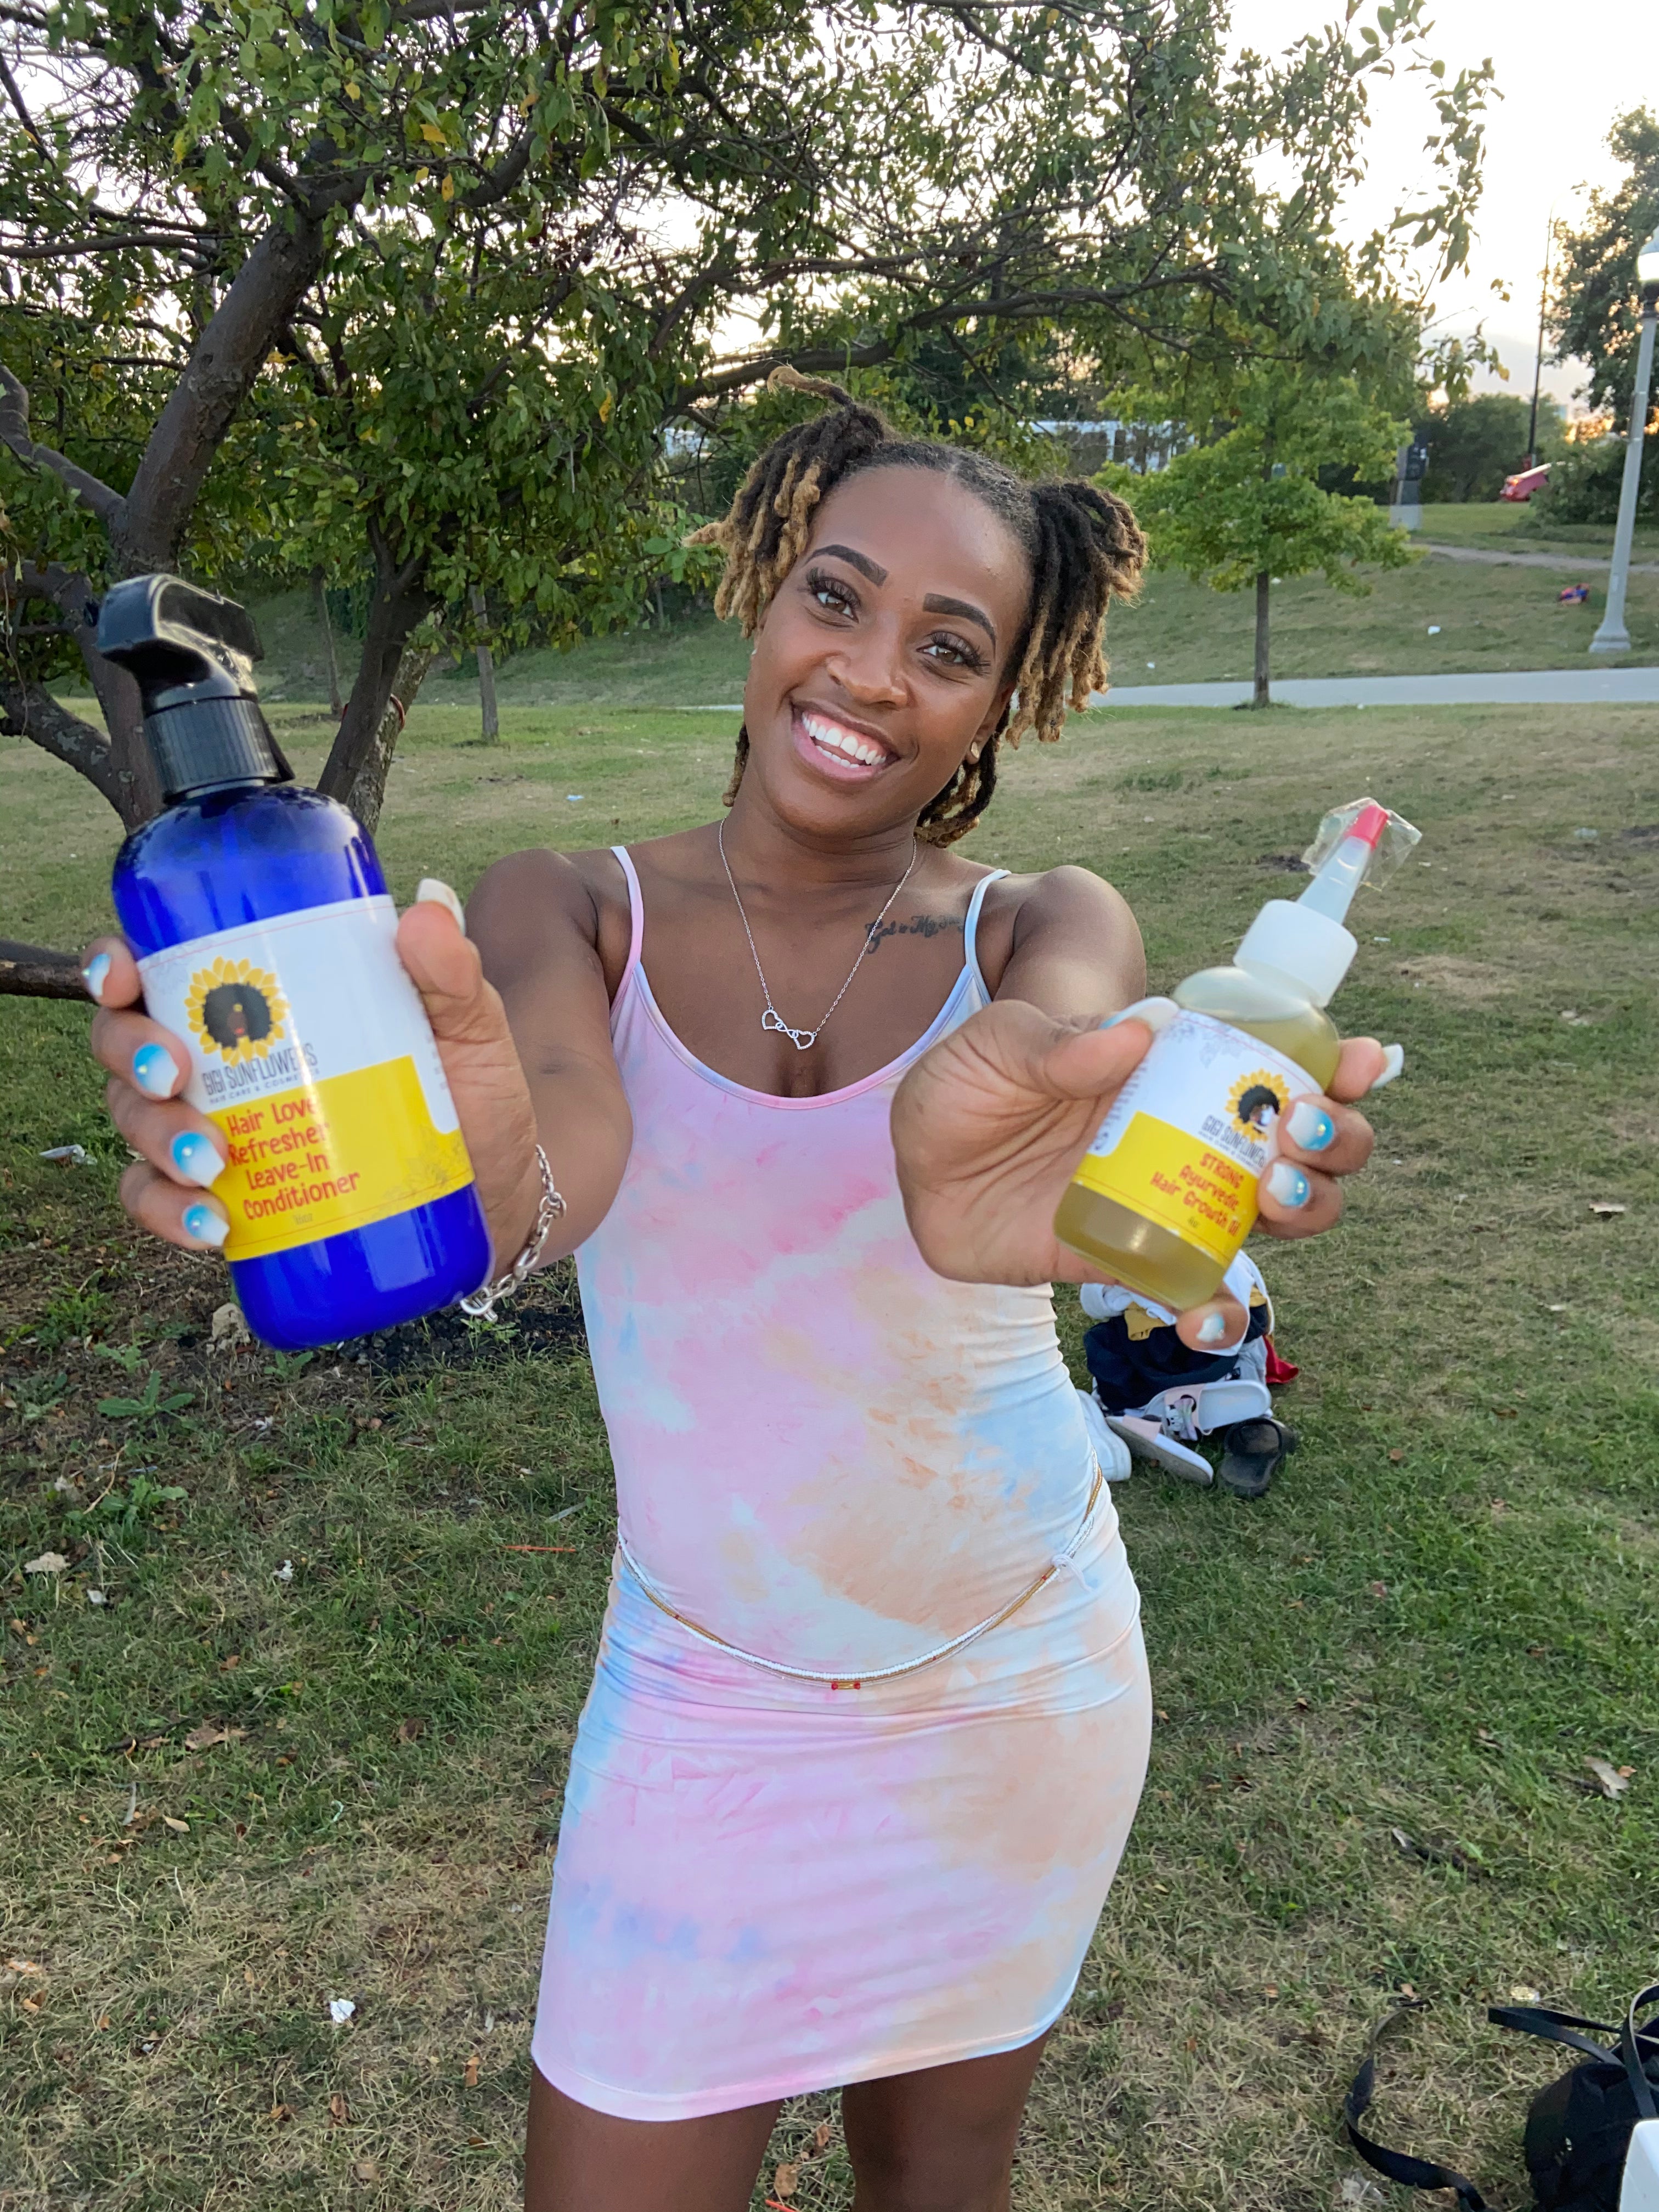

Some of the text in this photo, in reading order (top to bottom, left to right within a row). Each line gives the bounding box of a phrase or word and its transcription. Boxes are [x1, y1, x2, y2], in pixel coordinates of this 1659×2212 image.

[202, 1043, 318, 1096] GIGI SUNFLOWES
[265, 1069, 320, 1090] COSMES
[227, 1098, 317, 1137] Hair Love
[228, 1122, 330, 1166] Refresher
[245, 1152, 330, 1190] Leave-In
[1178, 1164, 1239, 1212] Ayurvedic
[1200, 1152, 1244, 1189] STRONG
[243, 1172, 360, 1221] Conditioner
[1150, 1171, 1181, 1196] Hair
[1183, 1190, 1228, 1229] Growth
